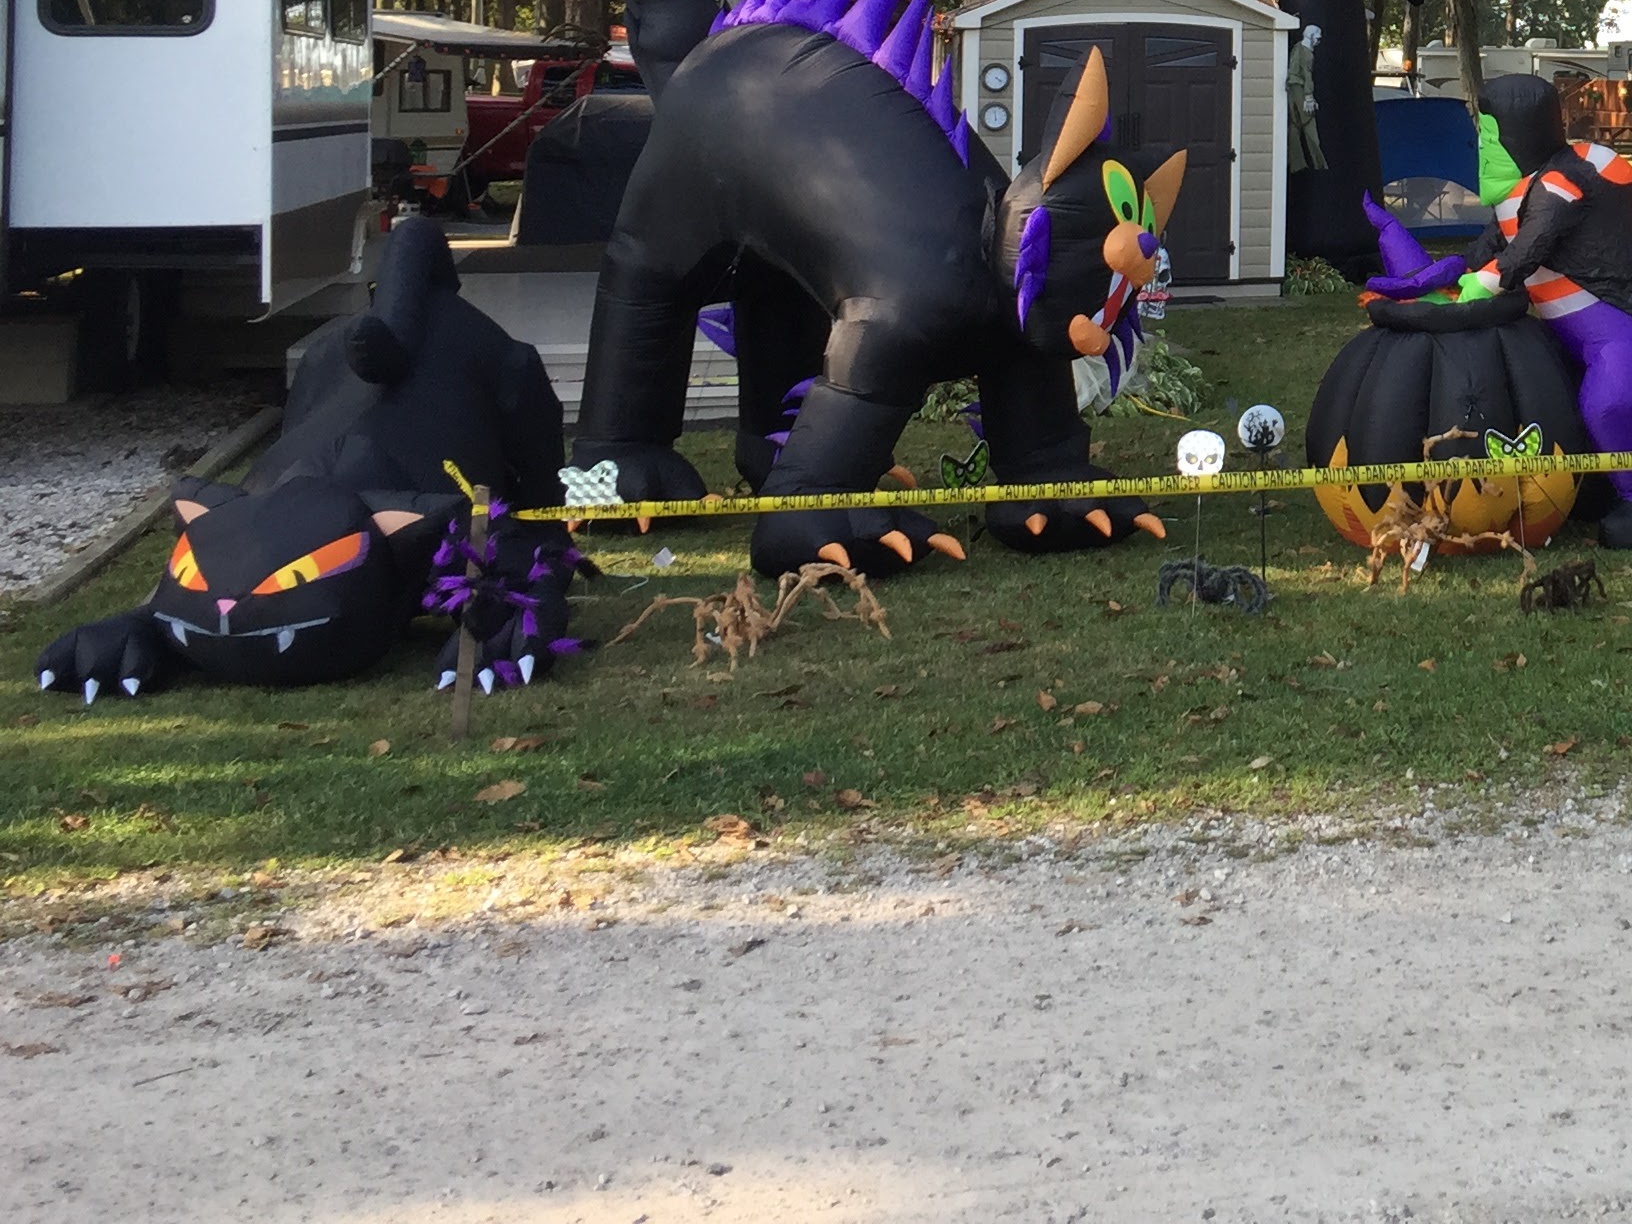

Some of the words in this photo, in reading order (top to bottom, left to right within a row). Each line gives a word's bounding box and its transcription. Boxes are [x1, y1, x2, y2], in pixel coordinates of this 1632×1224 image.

[887, 487, 987, 505] CAUTION-DANGER
[1000, 481, 1095, 499] CAUTION-DANGER
[1106, 476, 1200, 494] CAUTION-DANGER
[1211, 470, 1304, 491] CAUTION-DANGER
[1315, 464, 1406, 484] CAUTION-DANGER
[1416, 459, 1504, 478] CAUTION-DANGER
[1514, 454, 1601, 474] CAUTION-DANGER
